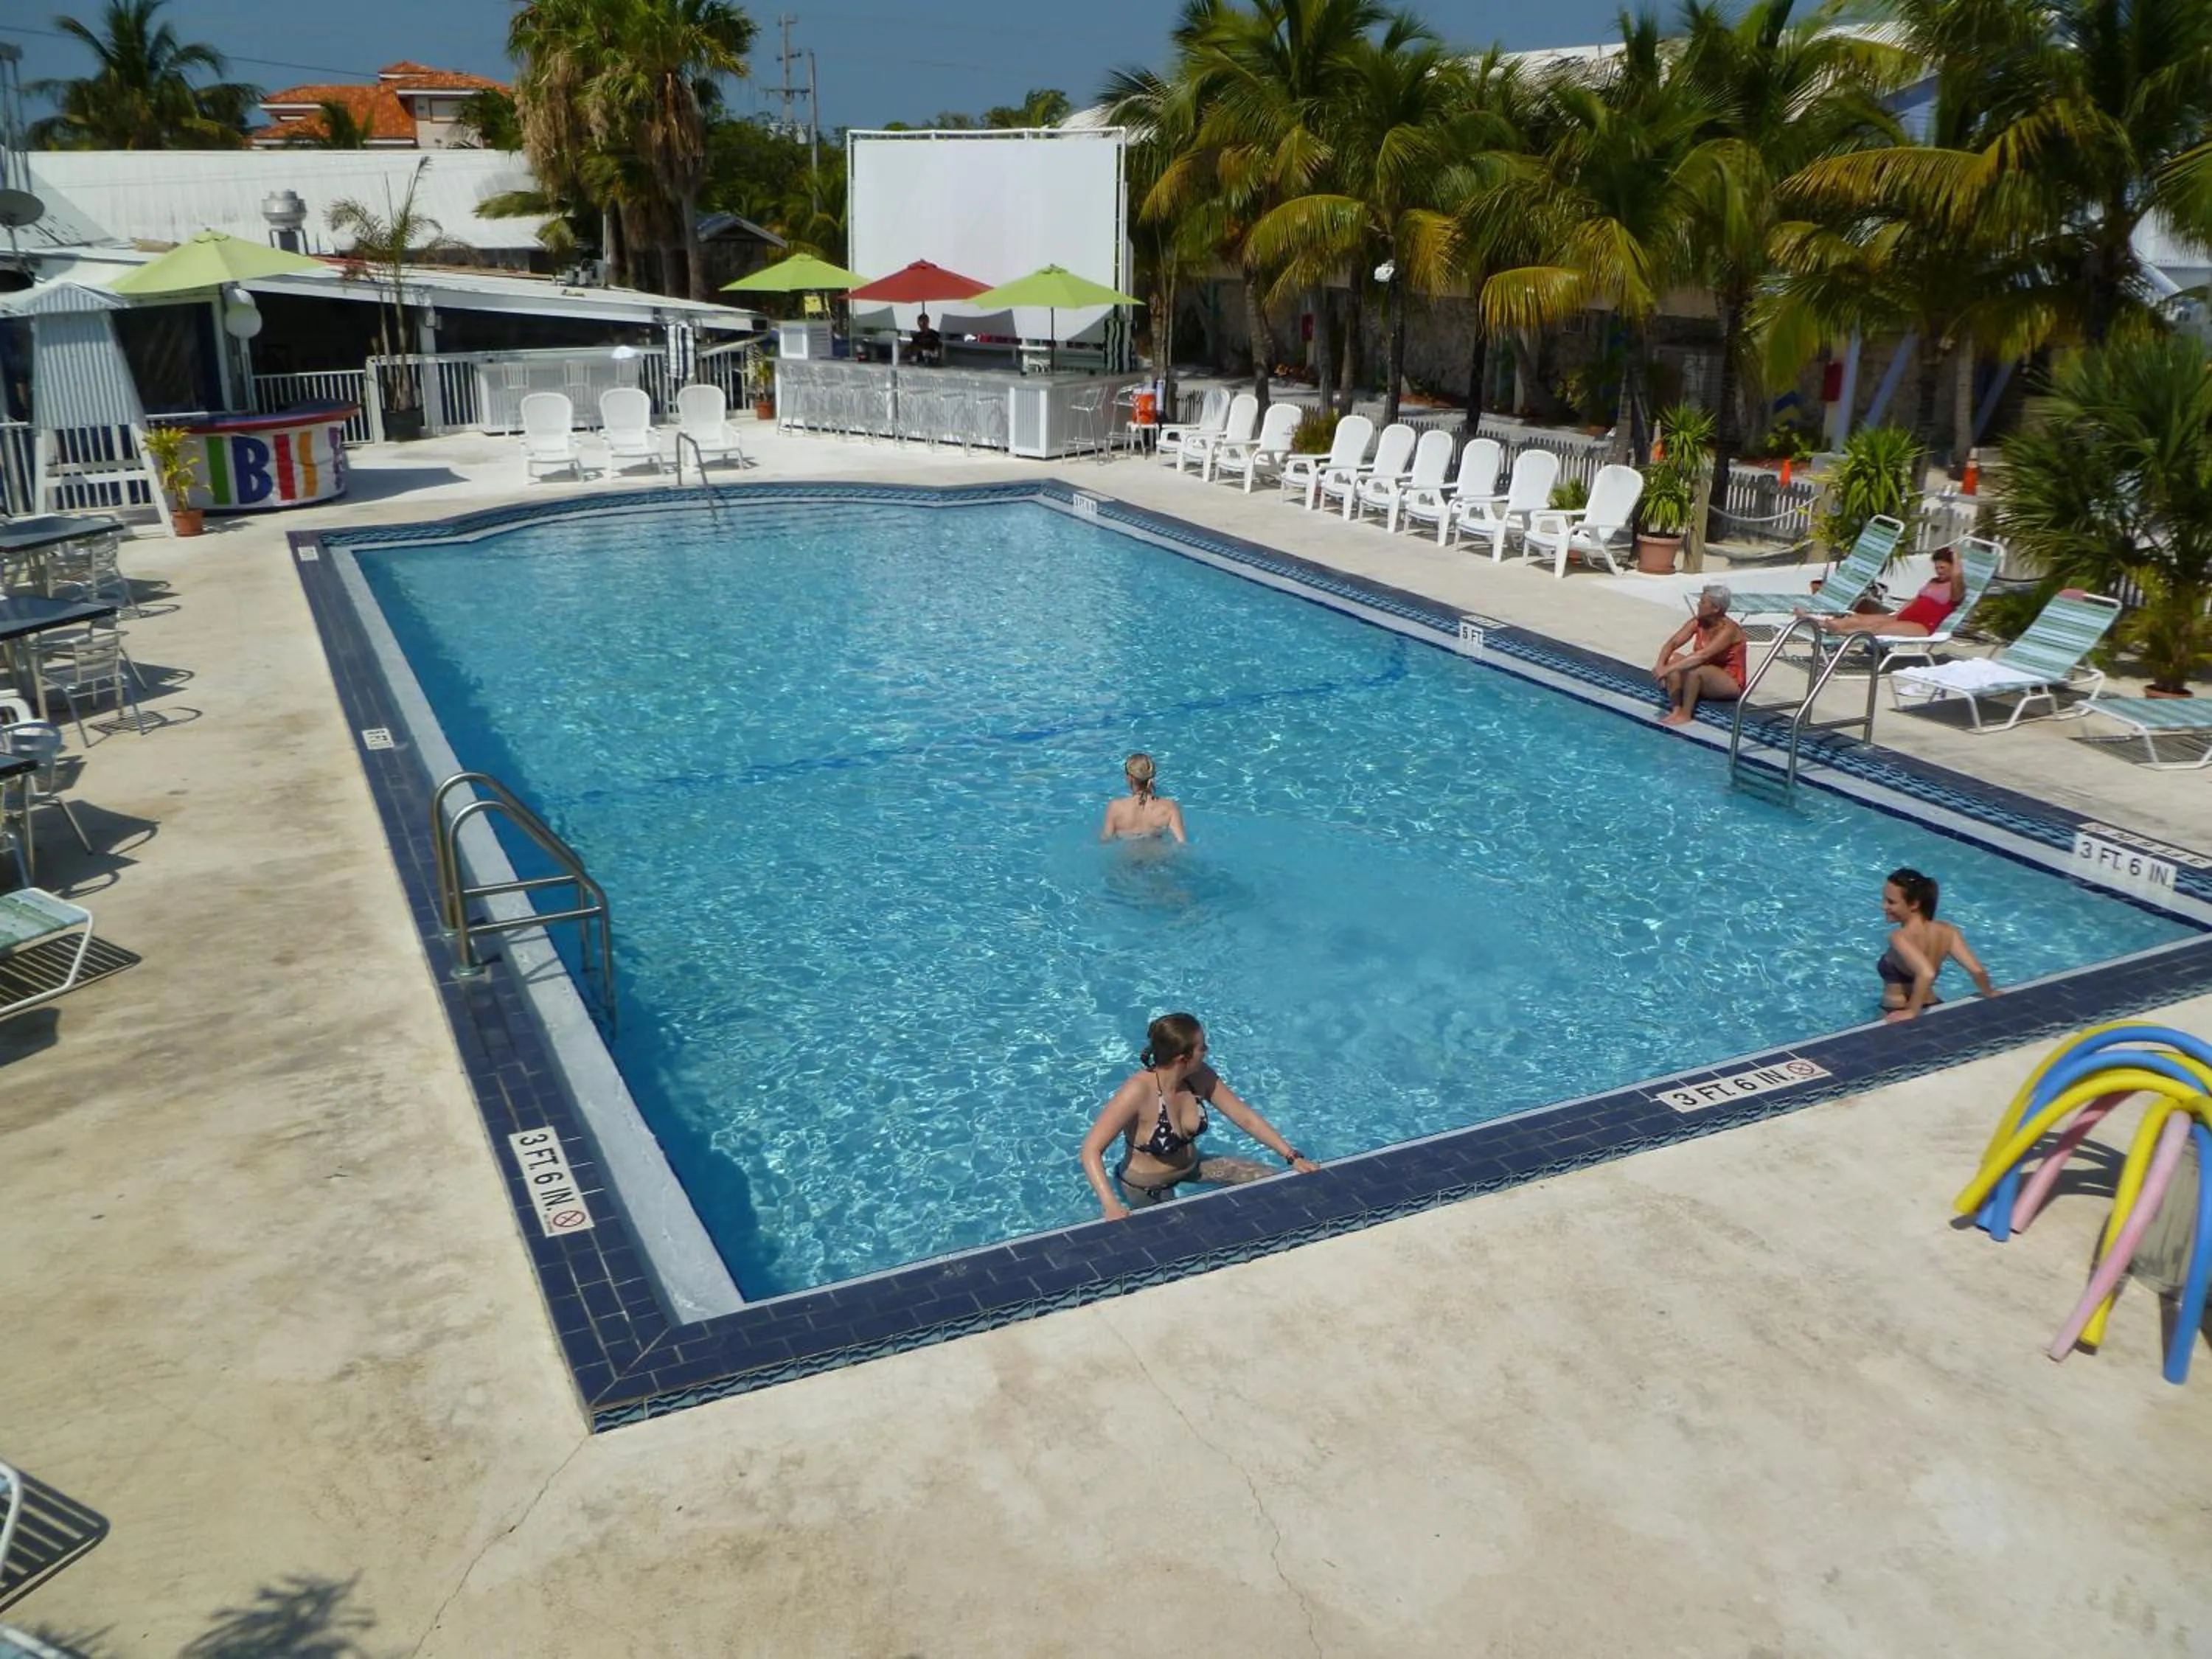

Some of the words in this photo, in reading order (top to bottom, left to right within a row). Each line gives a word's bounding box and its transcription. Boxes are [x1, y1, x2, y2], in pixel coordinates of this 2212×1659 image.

[2079, 841, 2093, 859] 3
[2129, 857, 2142, 876] 6
[1672, 1092, 1698, 1106] 3
[1695, 1082, 1736, 1101] FT.
[1733, 1078, 1759, 1091] 6
[1753, 1069, 1796, 1085] IN.
[519, 1133, 549, 1146] 3
[524, 1147, 560, 1170] FT.
[534, 1172, 564, 1185] 6
[540, 1186, 576, 1211] IN.
